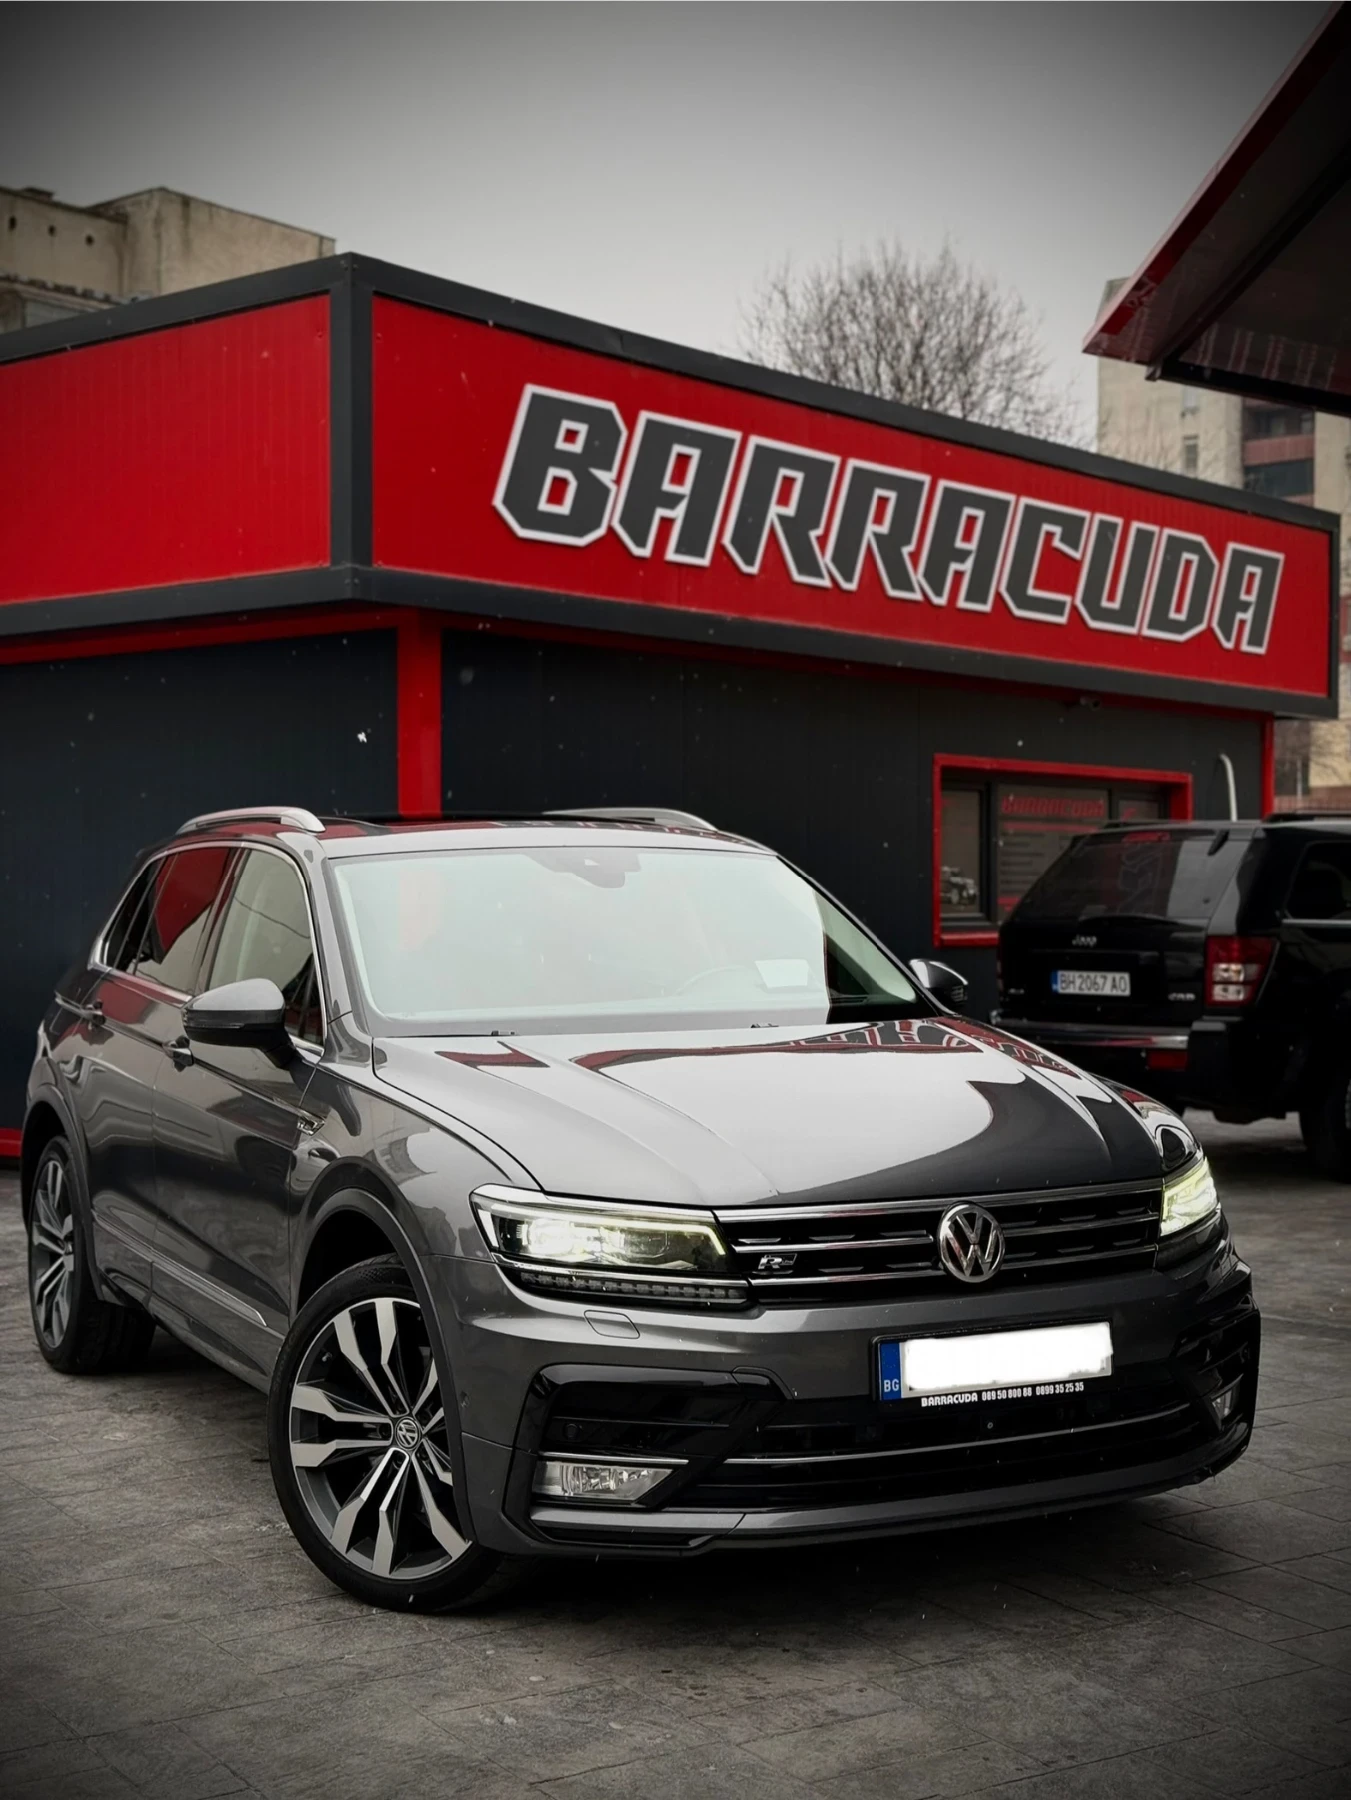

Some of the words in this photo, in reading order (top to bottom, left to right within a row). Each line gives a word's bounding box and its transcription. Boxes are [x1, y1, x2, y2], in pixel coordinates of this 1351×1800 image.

[493, 383, 1286, 655] BARRACUDA
[1060, 973, 1076, 991] BH
[1077, 974, 1107, 992] 2067
[883, 1378, 900, 1392] BG
[921, 1392, 978, 1407] BARRACUDA
[981, 1391, 996, 1401] 089
[1035, 1384, 1054, 1396] 0899
